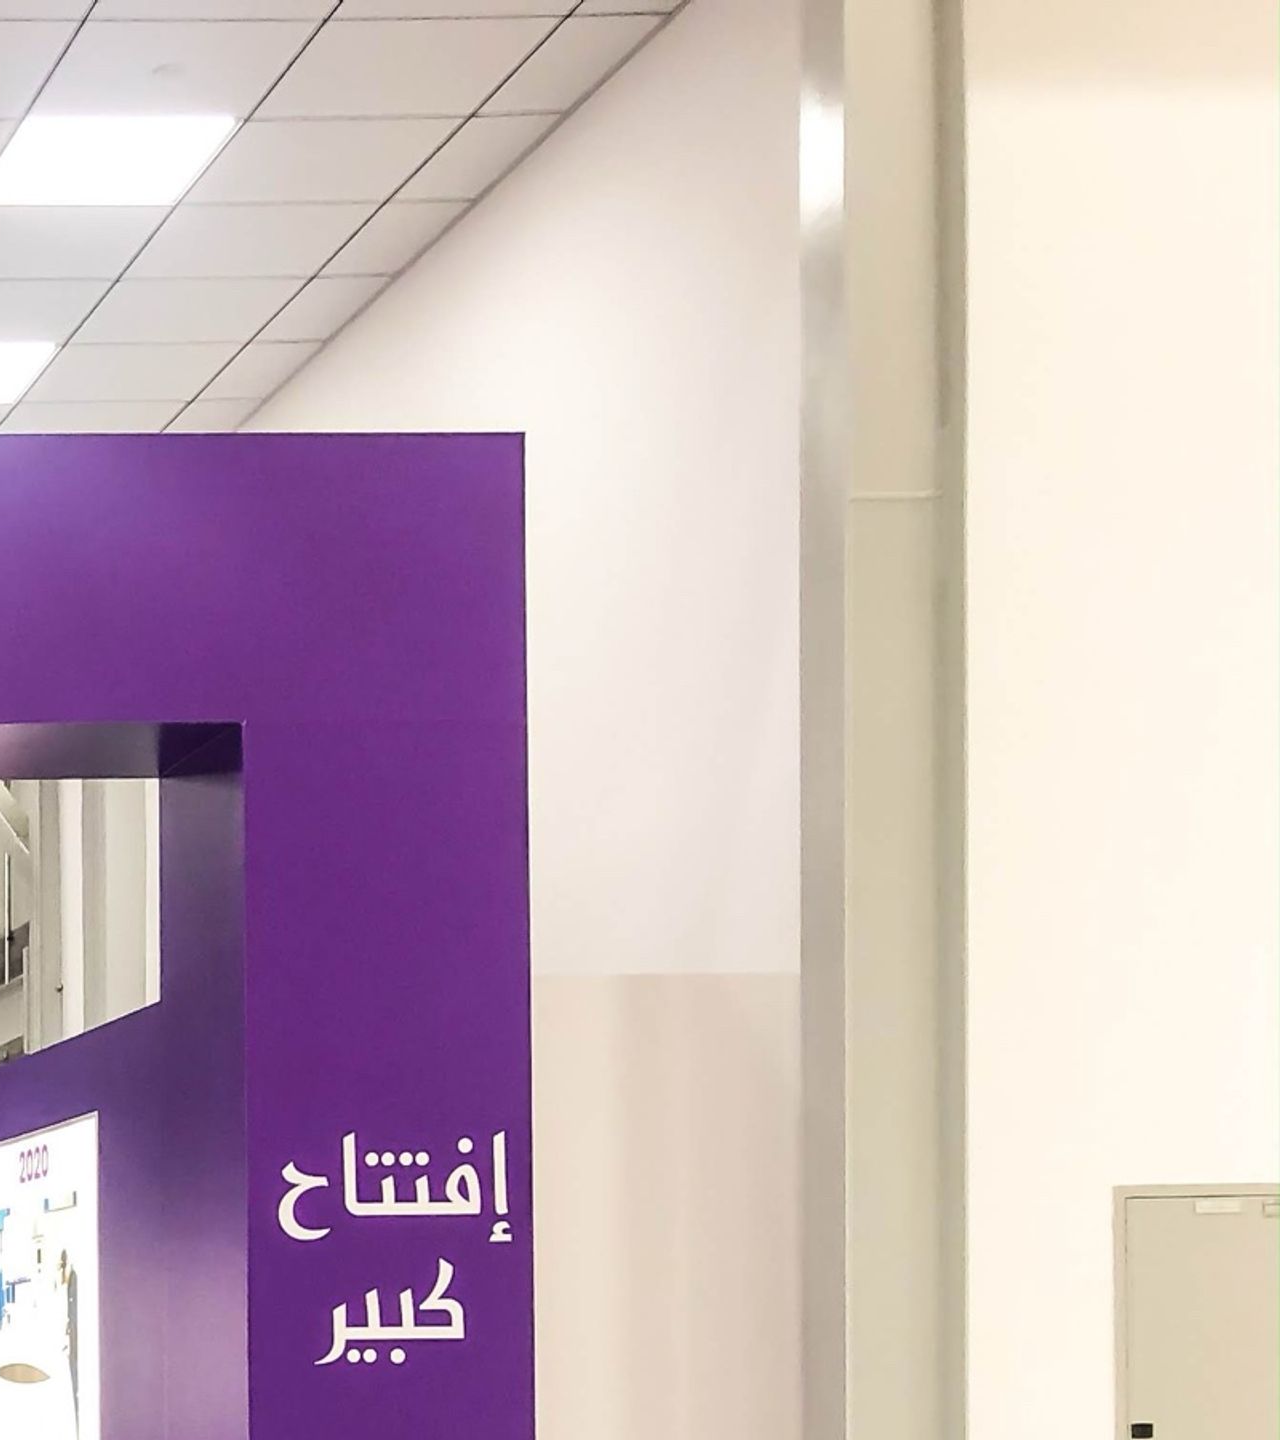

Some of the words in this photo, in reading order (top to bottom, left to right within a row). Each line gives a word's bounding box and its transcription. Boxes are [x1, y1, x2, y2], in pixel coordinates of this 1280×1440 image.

[19, 1144, 49, 1183] 2020
[277, 1130, 513, 1243] إفتتاح
[313, 1257, 465, 1366] كبير
